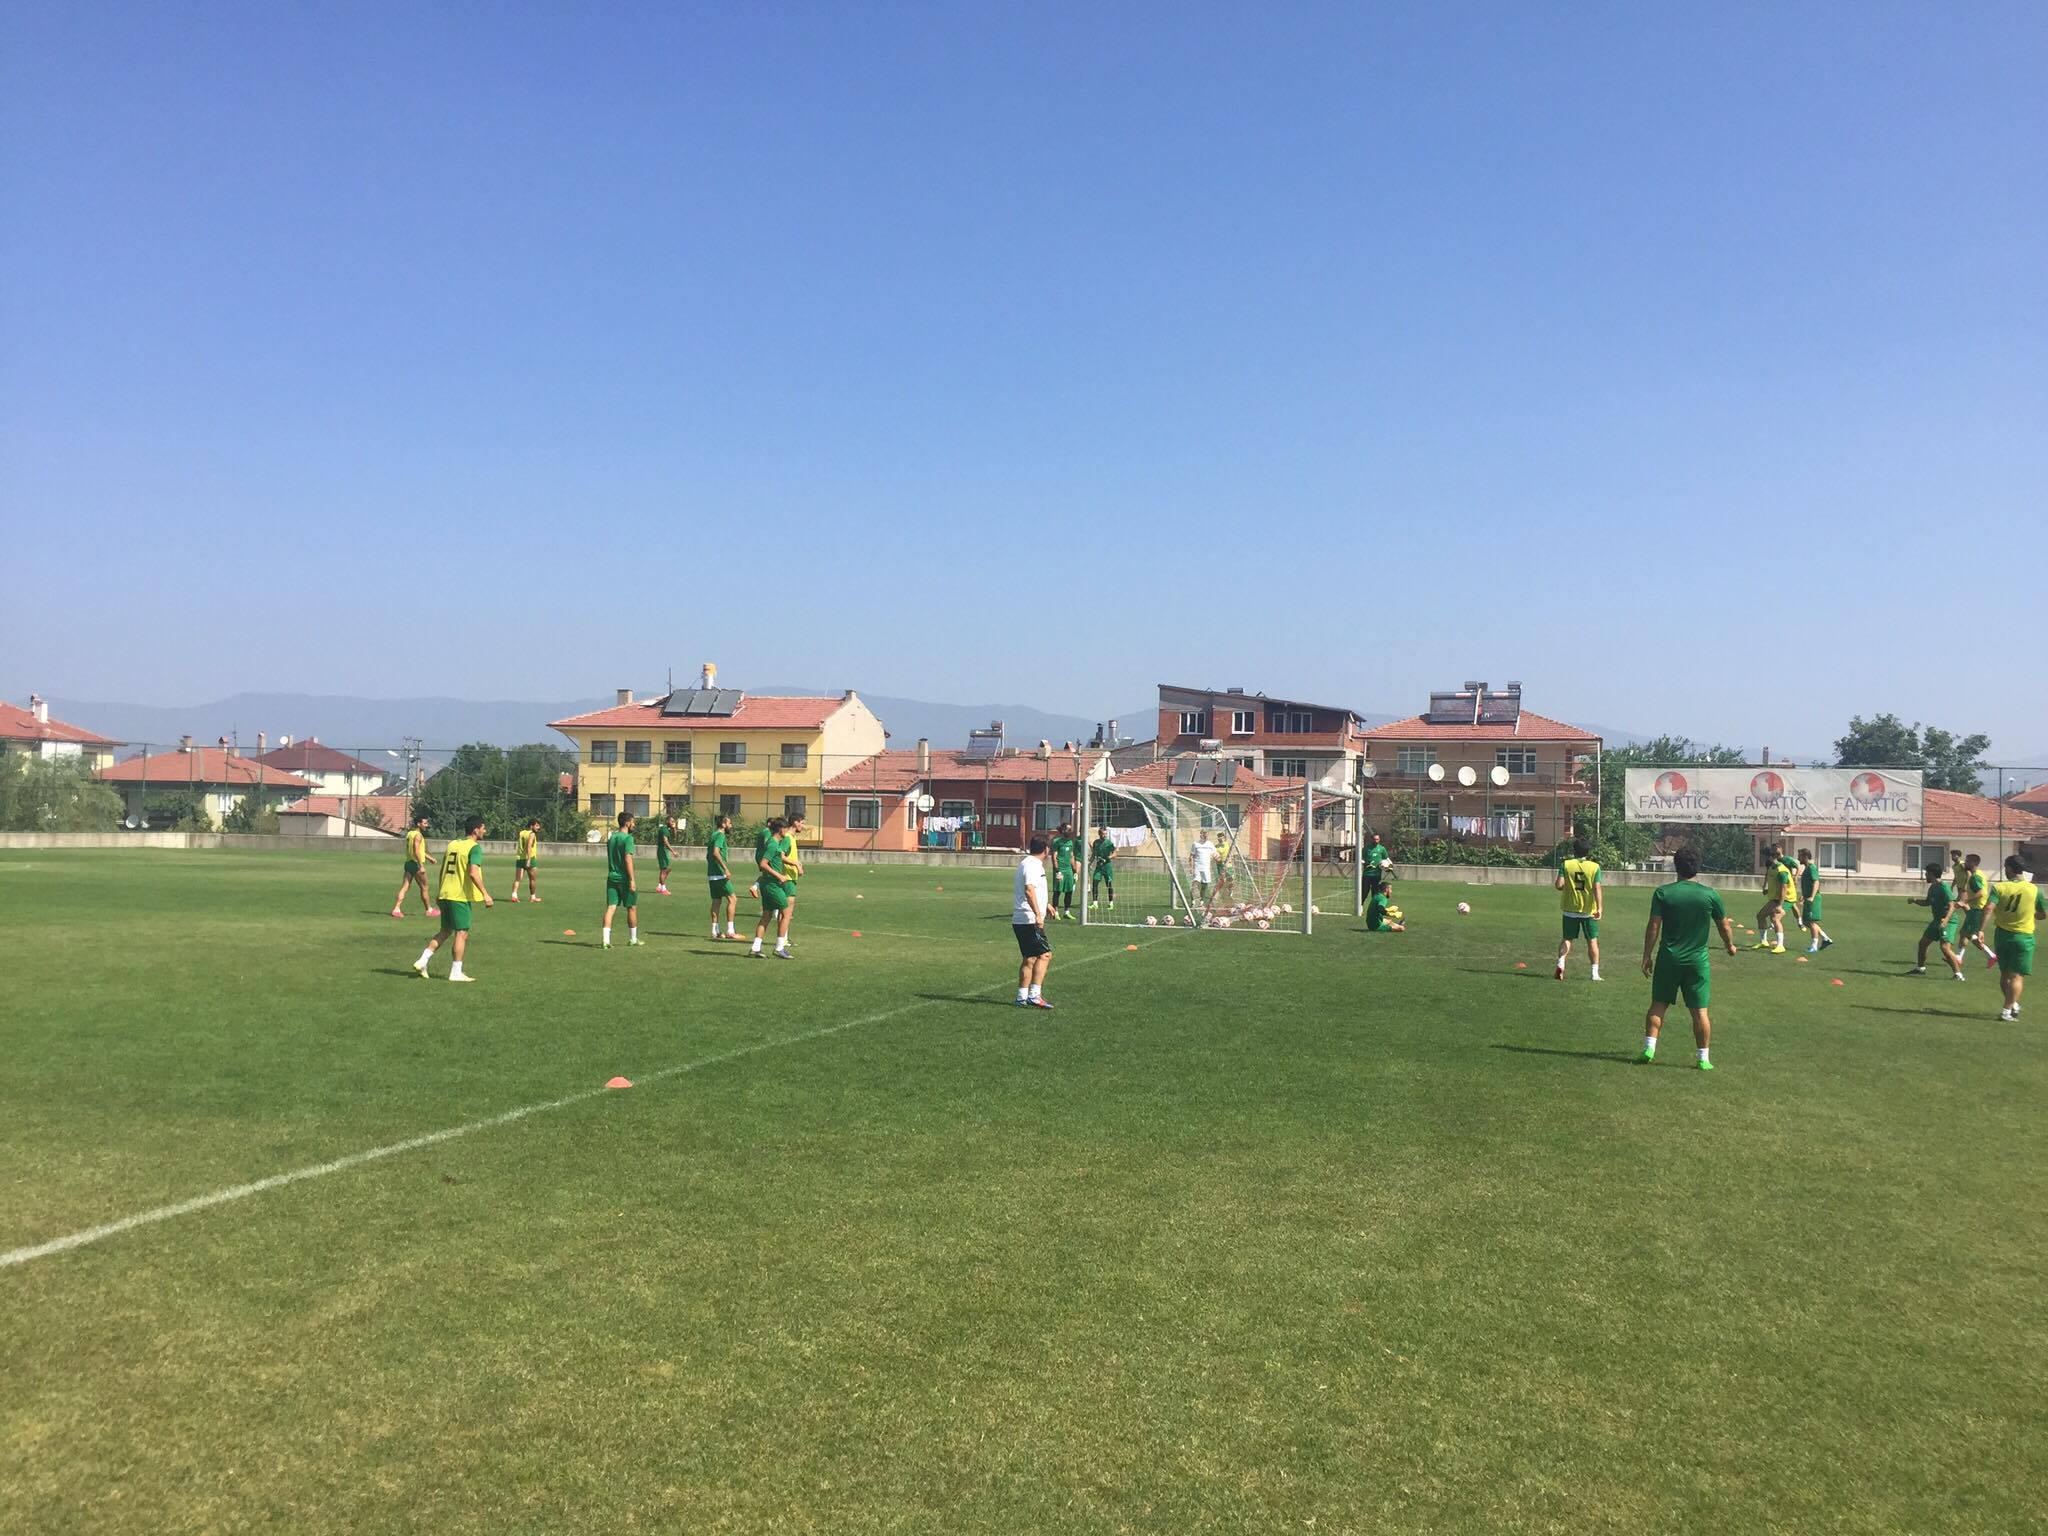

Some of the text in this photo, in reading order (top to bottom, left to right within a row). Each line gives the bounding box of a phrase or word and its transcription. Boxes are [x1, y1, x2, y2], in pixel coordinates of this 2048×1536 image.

[1639, 795, 1710, 809] FANATIC
[1734, 796, 1807, 810] FANATIC
[1834, 797, 1908, 812] FANATIC
[446, 851, 458, 874] 2
[1574, 871, 1585, 891] 5
[2005, 893, 2022, 912] 11
